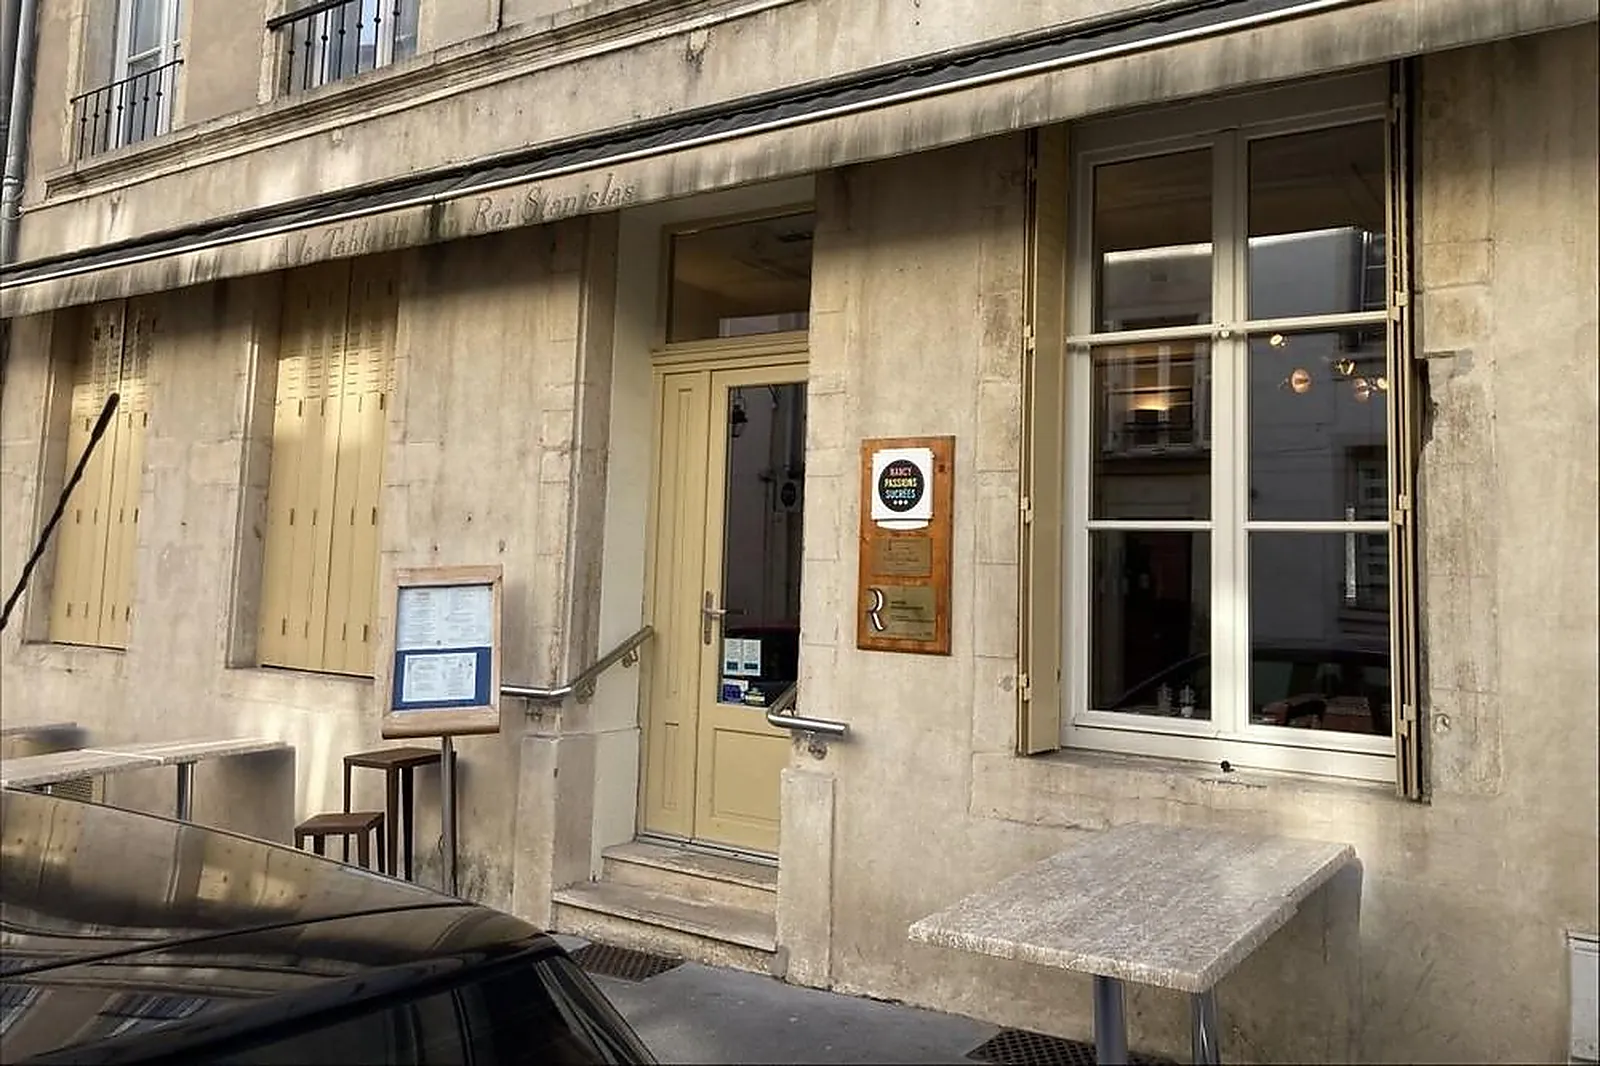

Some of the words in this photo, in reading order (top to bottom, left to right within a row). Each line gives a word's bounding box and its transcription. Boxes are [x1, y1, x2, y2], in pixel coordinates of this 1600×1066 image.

[472, 197, 515, 232] Roi
[522, 172, 637, 224] Stanislas
[884, 477, 917, 488] PASSIONS
